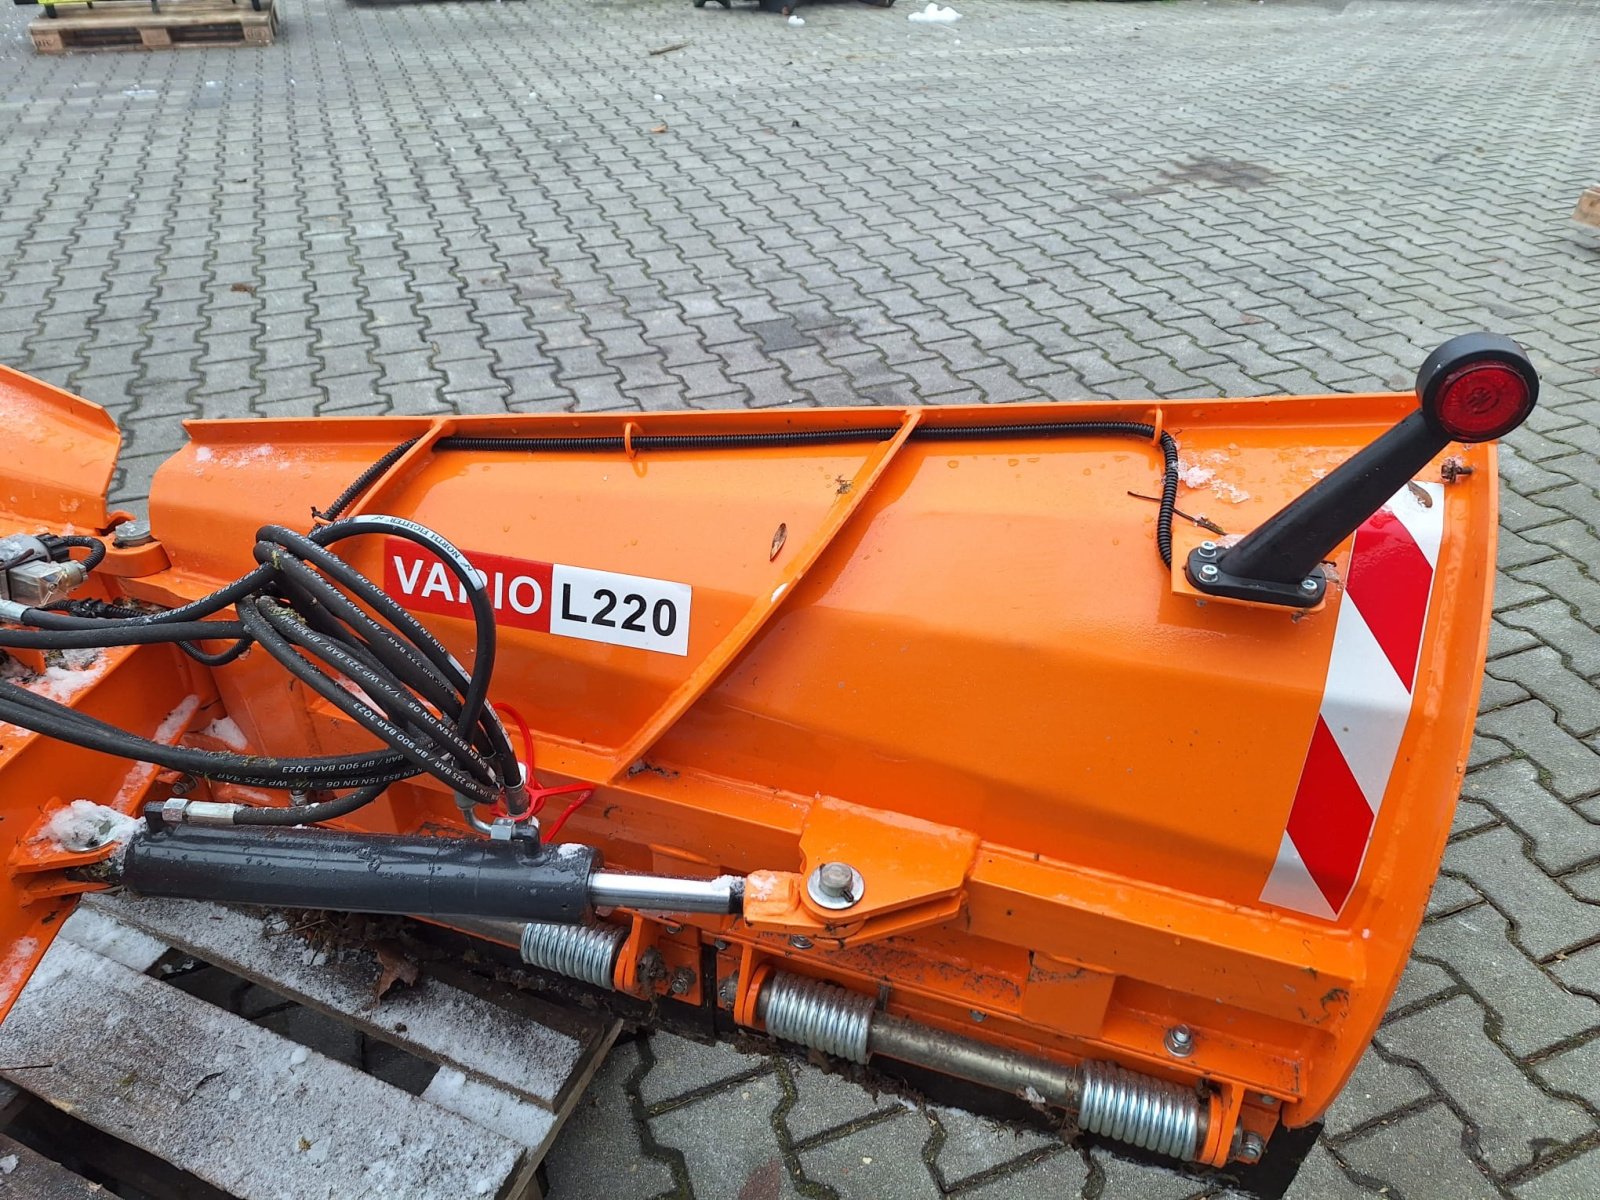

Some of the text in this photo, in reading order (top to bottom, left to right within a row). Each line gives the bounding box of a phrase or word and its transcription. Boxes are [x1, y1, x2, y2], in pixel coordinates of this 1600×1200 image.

[430, 533, 460, 560] NORTH
[325, 583, 347, 600] BAR
[369, 584, 385, 597] DN
[347, 601, 366, 618] 900
[561, 583, 677, 637] L220
[366, 619, 380, 630] BP
[307, 633, 320, 642] BP
[420, 627, 432, 639] EN
[325, 645, 345, 659] BAR
[432, 639, 446, 653] DIN
[345, 657, 363, 671] 225
[362, 670, 379, 683] WP
[353, 702, 378, 721] 3Q23
[407, 701, 421, 713] 06
[421, 711, 436, 724] DN
[377, 719, 397, 736] BAR
[436, 723, 452, 738] 1SN
[396, 734, 416, 749] 900
[385, 754, 404, 764] BAR
[415, 748, 429, 758] BP
[468, 749, 478, 760] EN
[282, 765, 311, 773] 3Q23
[313, 765, 336, 773] BAR
[338, 763, 359, 771] 900
[361, 760, 375, 769] BP
[434, 760, 452, 775] BAR
[244, 776, 266, 784] 225
[452, 772, 466, 784] 225
[465, 782, 477, 791] WP
